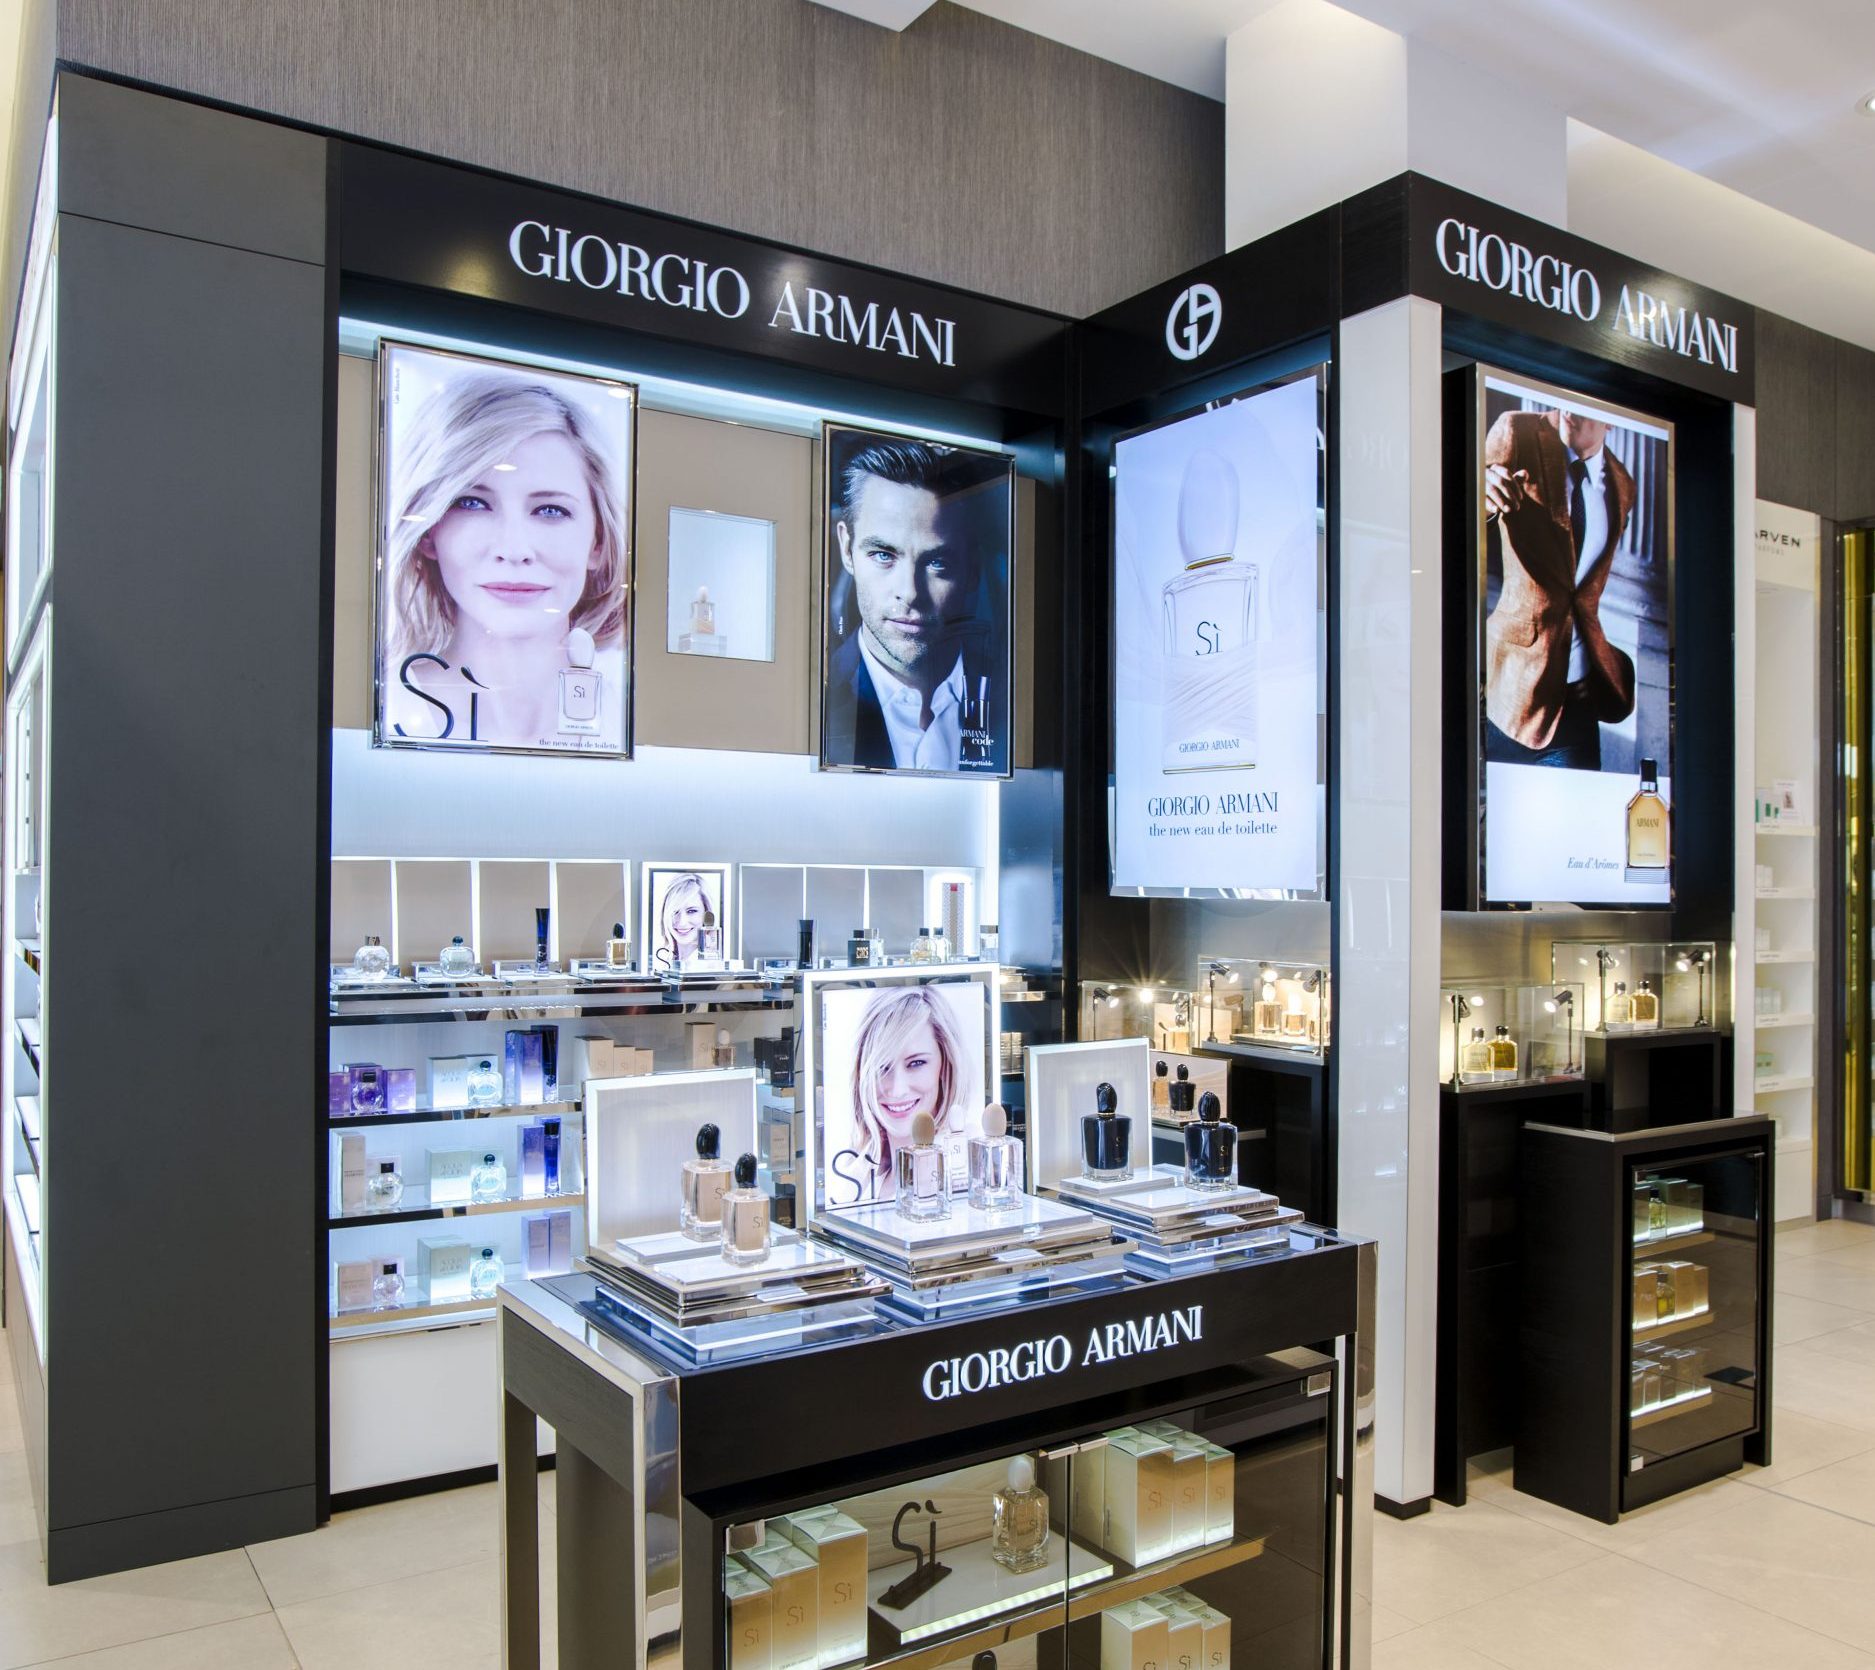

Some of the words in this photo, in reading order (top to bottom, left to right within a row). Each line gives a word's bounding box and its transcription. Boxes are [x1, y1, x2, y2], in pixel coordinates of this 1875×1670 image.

[509, 220, 751, 318] GIORGIO
[767, 281, 956, 367] ARMANI
[1436, 218, 1600, 321] GIORGIO
[1612, 283, 1738, 374] ARMANI
[1754, 529, 1800, 548] RVEN
[1194, 620, 1223, 656] Sì
[393, 652, 490, 741] Sì
[573, 685, 585, 698] Sì
[539, 739, 551, 747] the
[595, 742, 619, 750] toilette
[960, 730, 986, 738] ARMANI
[971, 734, 994, 746] code
[1178, 740, 1209, 753] GIORGIO
[1211, 738, 1240, 751] ARMANI
[1148, 794, 1210, 818] GIORGIO
[1216, 791, 1279, 815] ARMANI
[1149, 823, 1166, 837] the
[1169, 825, 1190, 837] new
[1195, 825, 1214, 836] eau
[1217, 821, 1232, 836] de
[1235, 820, 1278, 835] toilette
[1567, 857, 1584, 869] Eau
[830, 1149, 880, 1206] Sì
[922, 1334, 1072, 1401] GIORGIO
[1082, 1305, 1203, 1366] ARMANI
[834, 1582, 854, 1605] Sì
[786, 1605, 805, 1627] Sì
[743, 1628, 760, 1648] Sì
